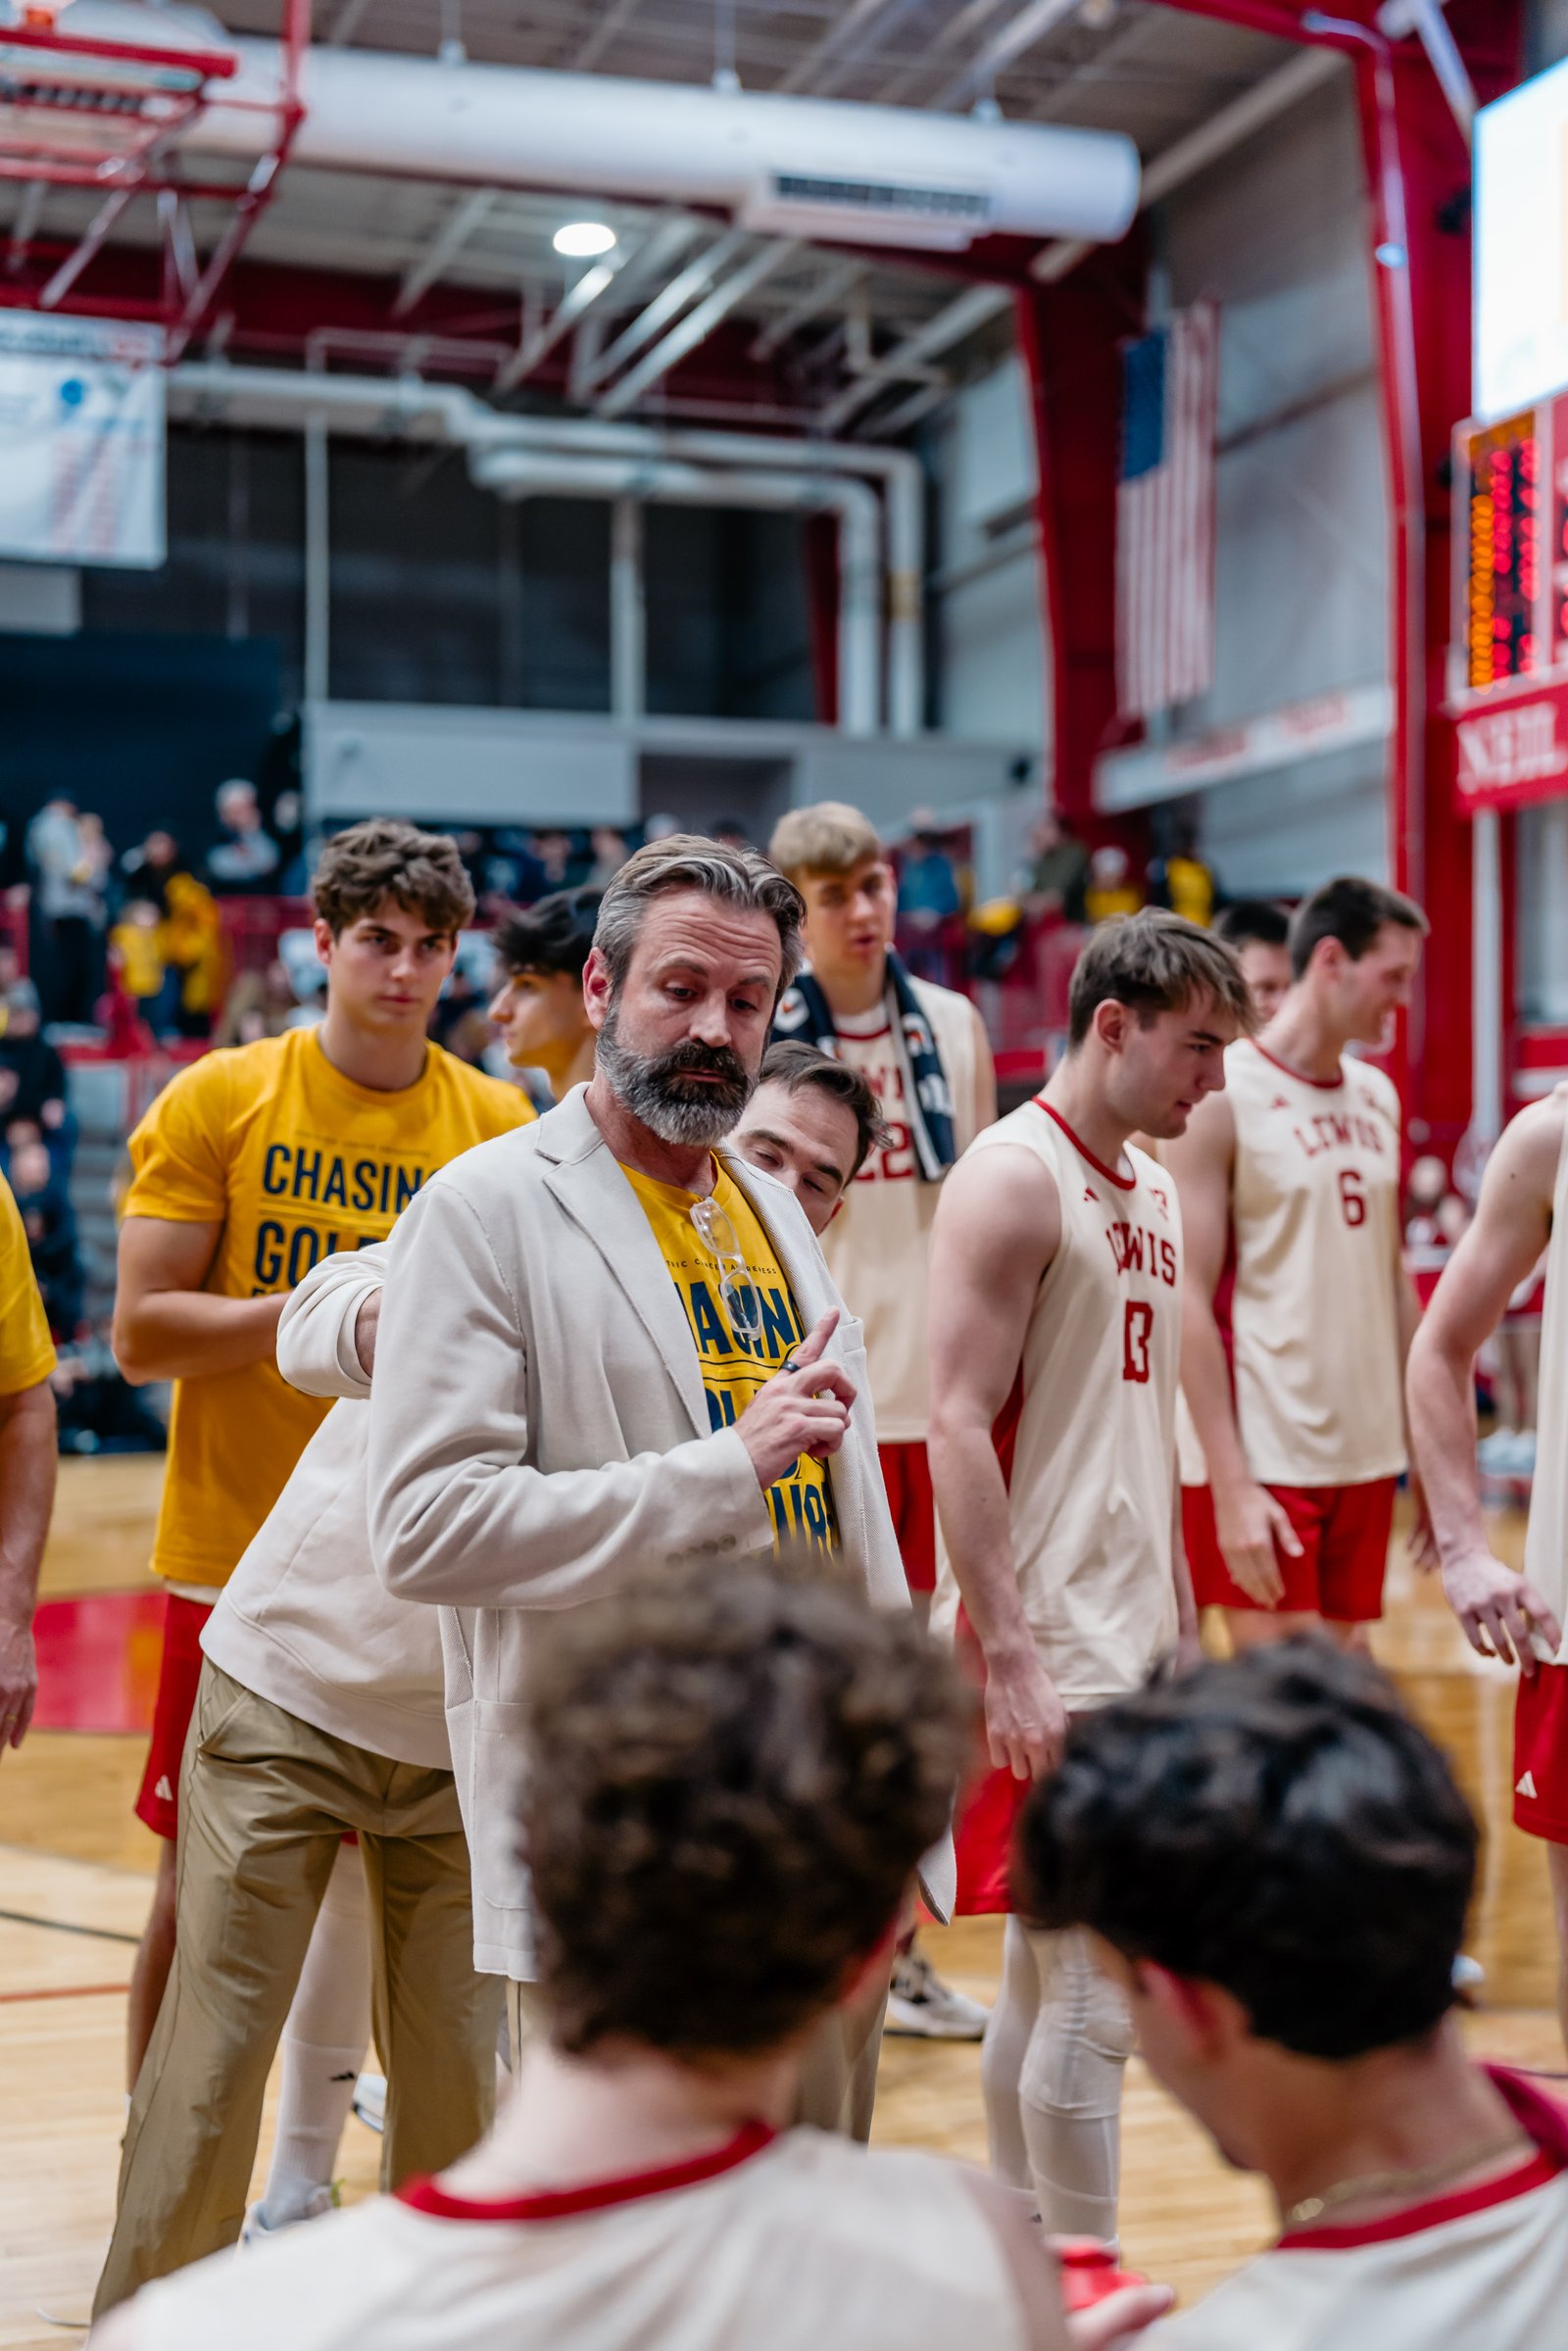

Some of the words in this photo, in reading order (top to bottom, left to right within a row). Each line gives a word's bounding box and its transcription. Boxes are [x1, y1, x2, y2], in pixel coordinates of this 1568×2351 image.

[263, 1144, 440, 1214] CHASIN
[1339, 1169, 1365, 1229] 6
[1123, 1298, 1153, 1384] 13
